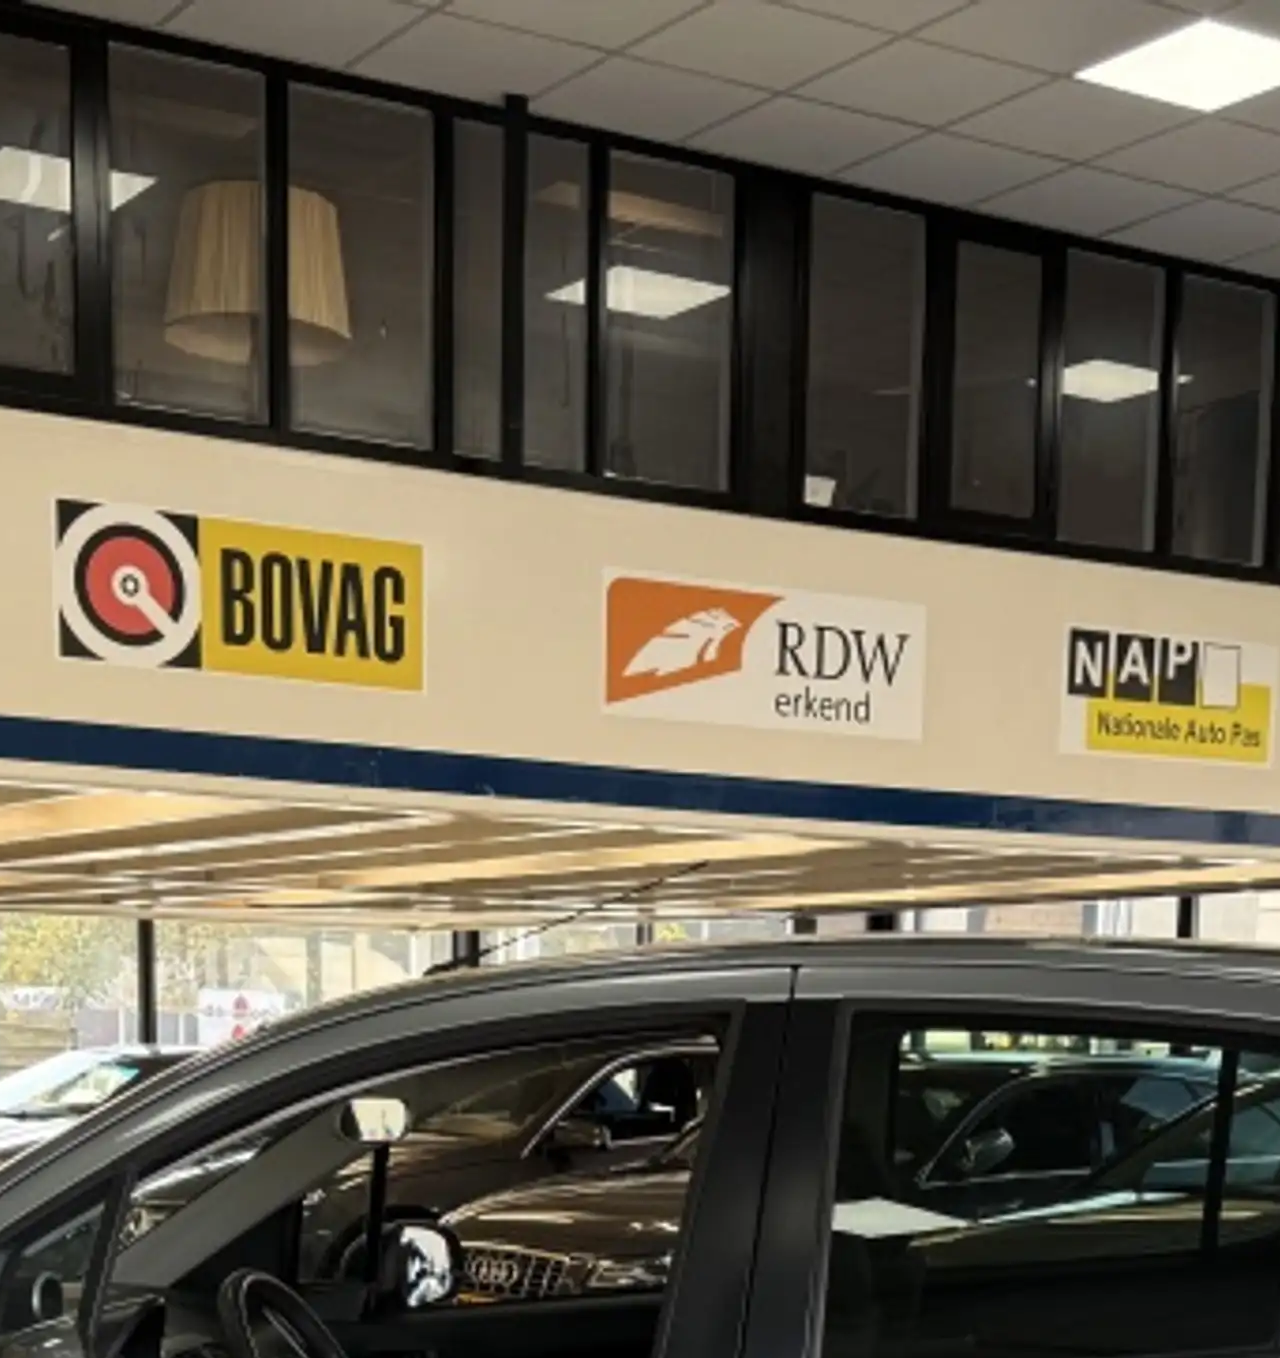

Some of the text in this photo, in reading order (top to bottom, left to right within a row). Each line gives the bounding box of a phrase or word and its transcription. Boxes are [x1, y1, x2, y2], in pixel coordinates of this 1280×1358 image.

[220, 547, 405, 664] BOVAG
[775, 619, 911, 687] RDW
[1073, 637, 1194, 688] NAP
[775, 686, 871, 726] erkend
[1097, 710, 1261, 748] Nationale Auto Pas
